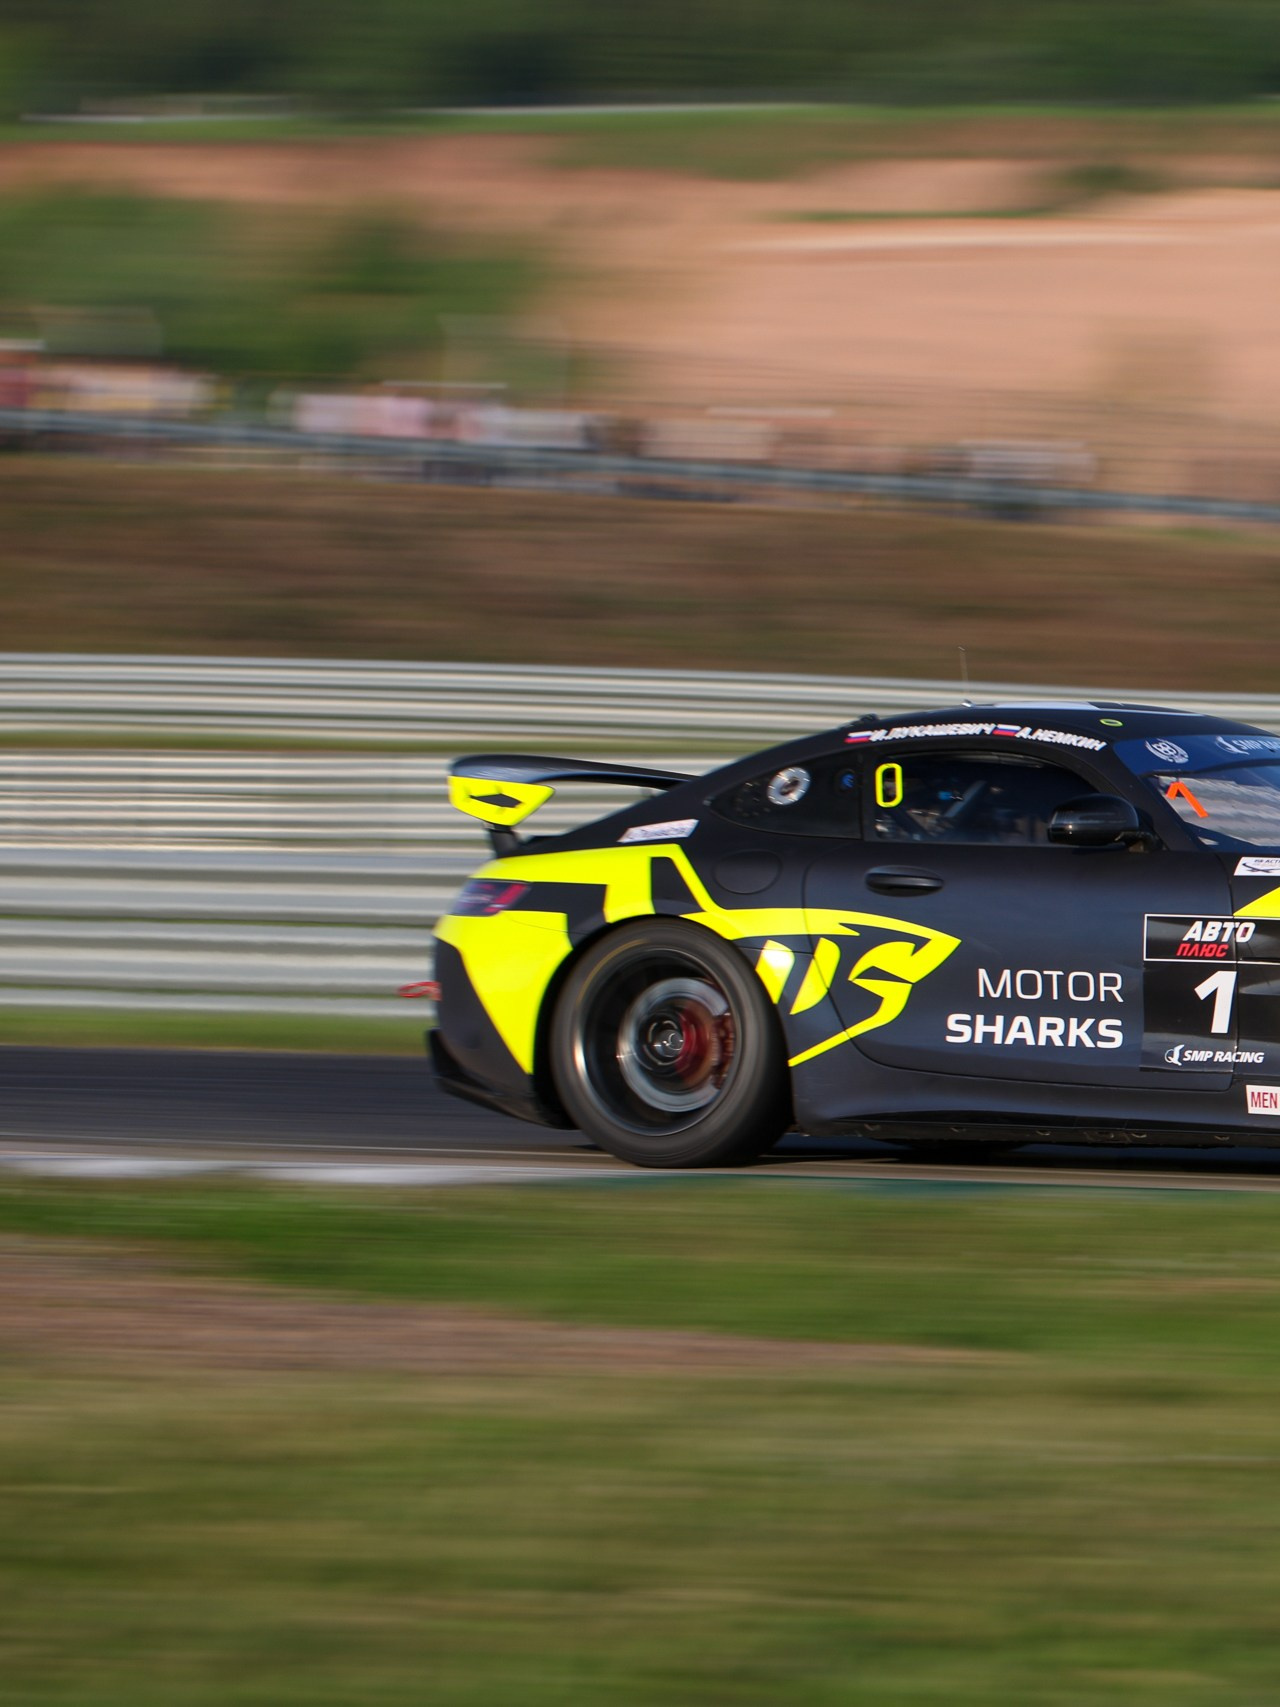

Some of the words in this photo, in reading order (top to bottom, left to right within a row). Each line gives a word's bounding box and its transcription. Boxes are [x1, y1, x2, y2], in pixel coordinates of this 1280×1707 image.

[1015, 726, 1108, 751] А.НЕМКИН
[1182, 920, 1256, 943] АВТО
[1176, 943, 1229, 957] ПЛЮС
[977, 968, 1124, 1003] MOTOR
[1194, 970, 1237, 1034] 1
[945, 1012, 1124, 1049] SHARKS
[1182, 1050, 1214, 1062] SMP
[1213, 1051, 1265, 1064] RACING
[1250, 1091, 1278, 1109] MEN
